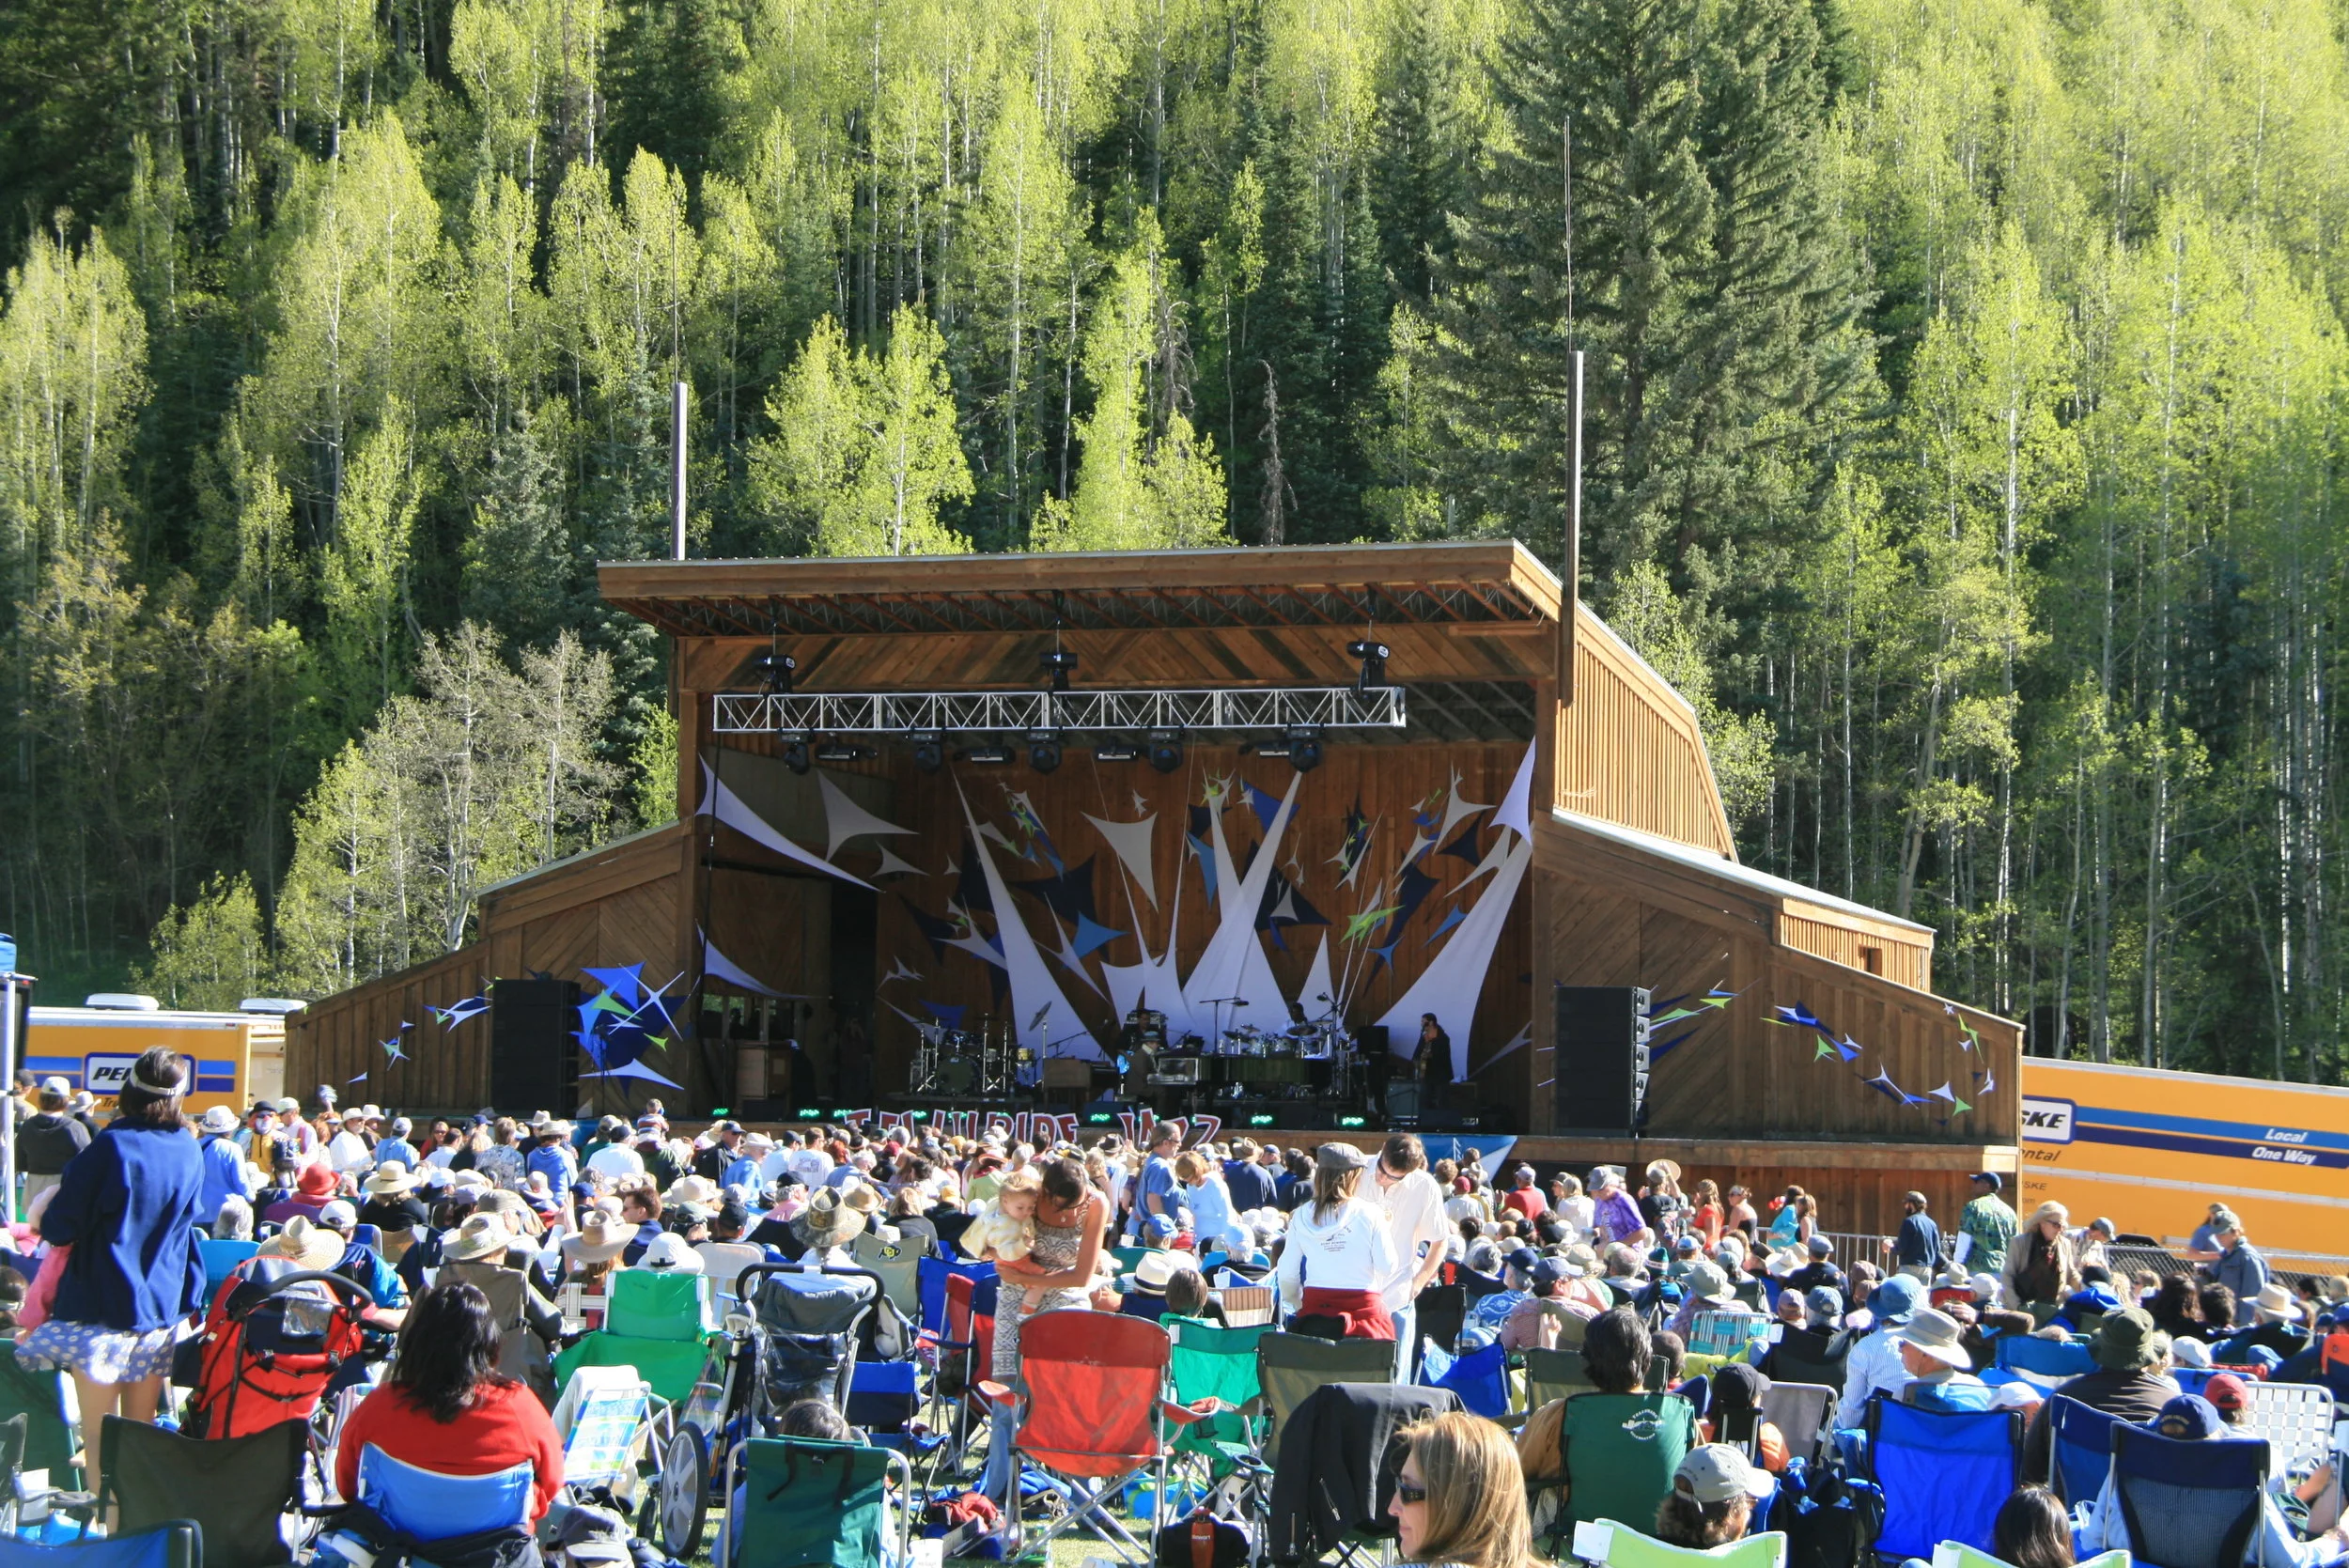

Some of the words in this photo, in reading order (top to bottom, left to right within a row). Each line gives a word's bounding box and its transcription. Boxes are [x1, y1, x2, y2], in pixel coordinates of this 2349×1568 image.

[2264, 1128, 2309, 1142] Local
[2251, 1146, 2283, 1160] One
[2283, 1149, 2317, 1166] Way
